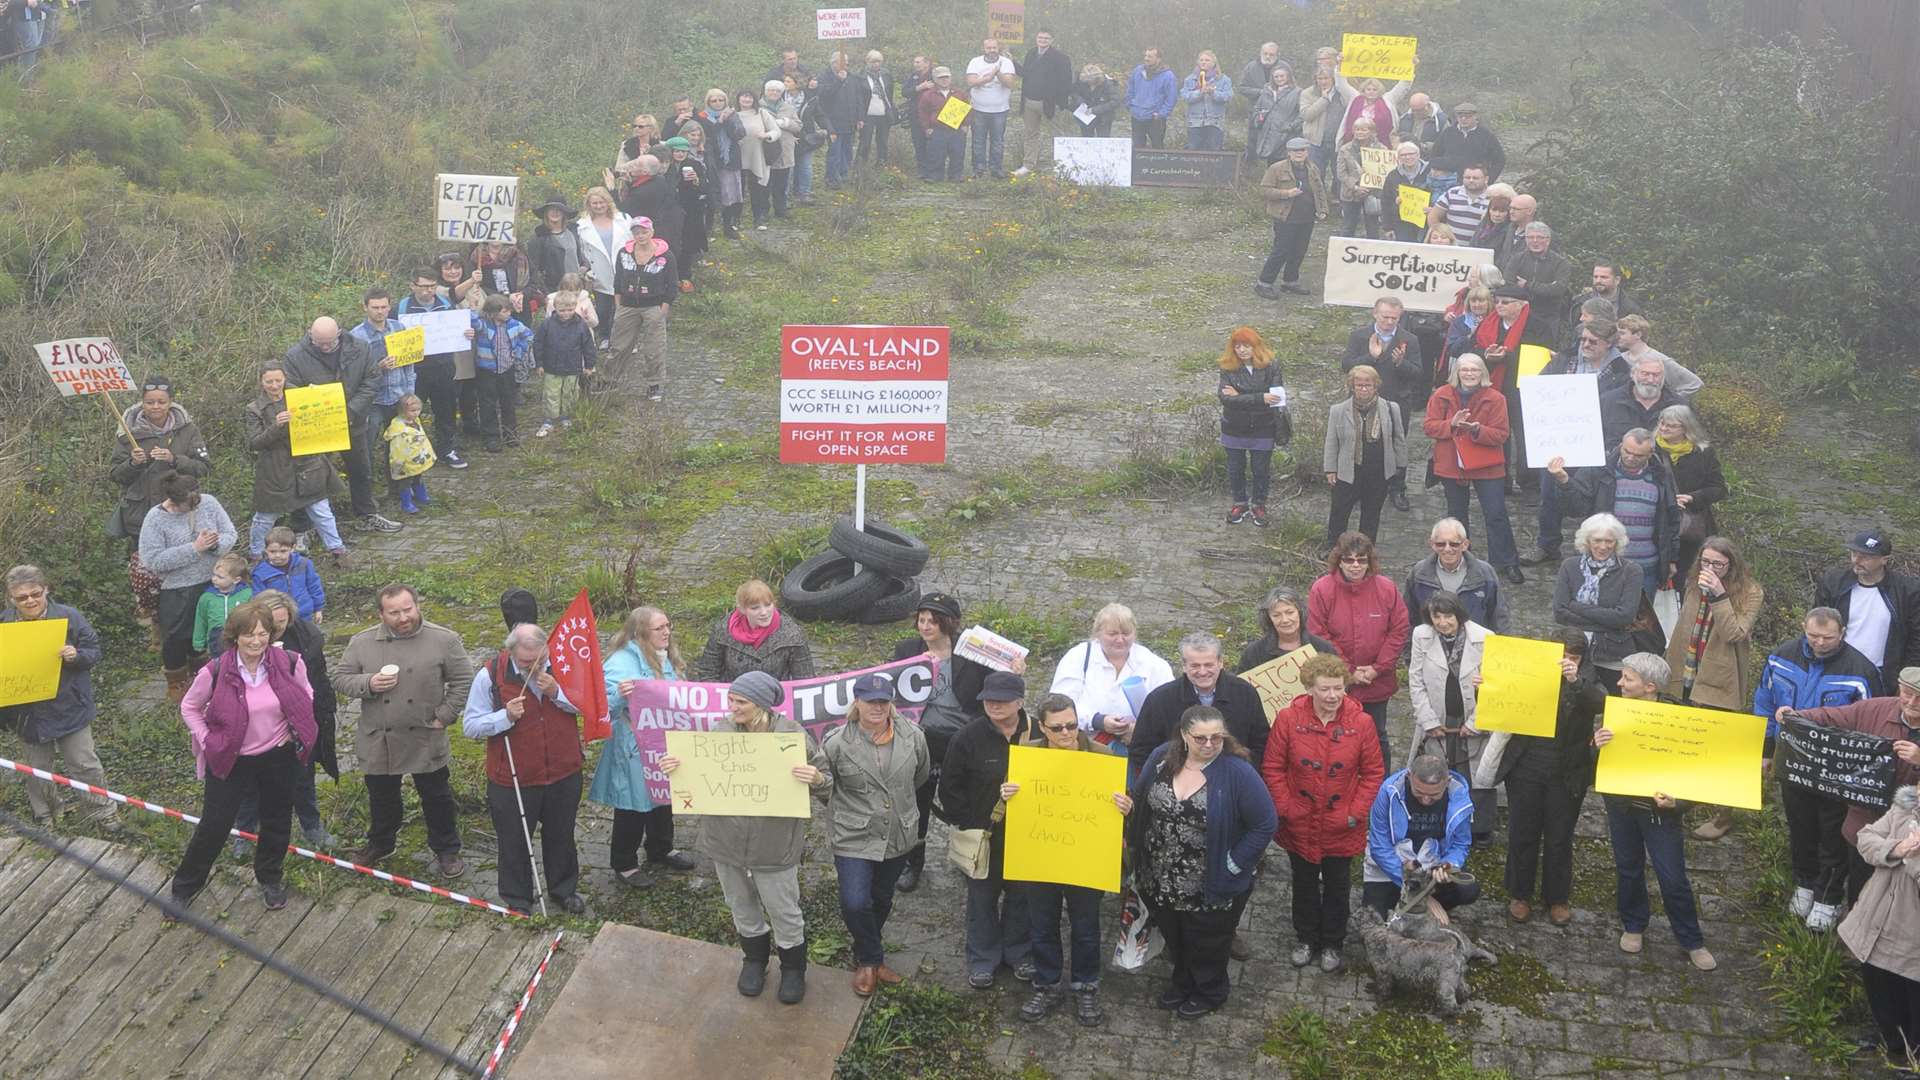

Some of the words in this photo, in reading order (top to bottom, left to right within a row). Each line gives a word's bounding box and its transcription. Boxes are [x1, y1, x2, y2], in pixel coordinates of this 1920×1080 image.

[443, 182, 517, 207] RETURN
[464, 206, 492, 221] TO
[439, 220, 513, 241] TENDER
[791, 337, 860, 356] OVAL
[869, 338, 940, 356] LAND
[80, 367, 120, 381] HAVE
[808, 359, 865, 372] (REEVES
[869, 359, 922, 373] BEACH)
[72, 379, 129, 395] PLEASE
[788, 389, 816, 400] CCC
[821, 389, 875, 400] SELLING
[879, 390, 942, 401] £160,000?
[789, 403, 840, 414] WORTH
[845, 404, 860, 414] £1
[791, 430, 834, 442] FIGHT
[840, 431, 852, 441] IT
[857, 431, 885, 442] FOR
[892, 431, 936, 442] MORE
[818, 445, 859, 456] OPEN
[864, 445, 909, 457] SPACE
[668, 686, 709, 710] NO
[637, 707, 734, 731] AUSTE
[1809, 730, 1829, 742] OH
[1840, 738, 1883, 751] DEAR!
[692, 735, 757, 764] Right
[1820, 747, 1872, 762] STUMPED
[1875, 755, 1893, 764] AT
[720, 763, 758, 773] this
[1785, 759, 1812, 773] LOST
[1807, 753, 1828, 767] THE
[700, 774, 769, 803] Wrong
[1029, 779, 1073, 797] THIS
[1788, 773, 1814, 788] SAVE
[1818, 783, 1842, 796] OUR
[1842, 789, 1888, 807] SEASIDE.
[1037, 803, 1054, 817] IS
[1061, 810, 1098, 828] OUR
[1029, 820, 1076, 846] LAND
